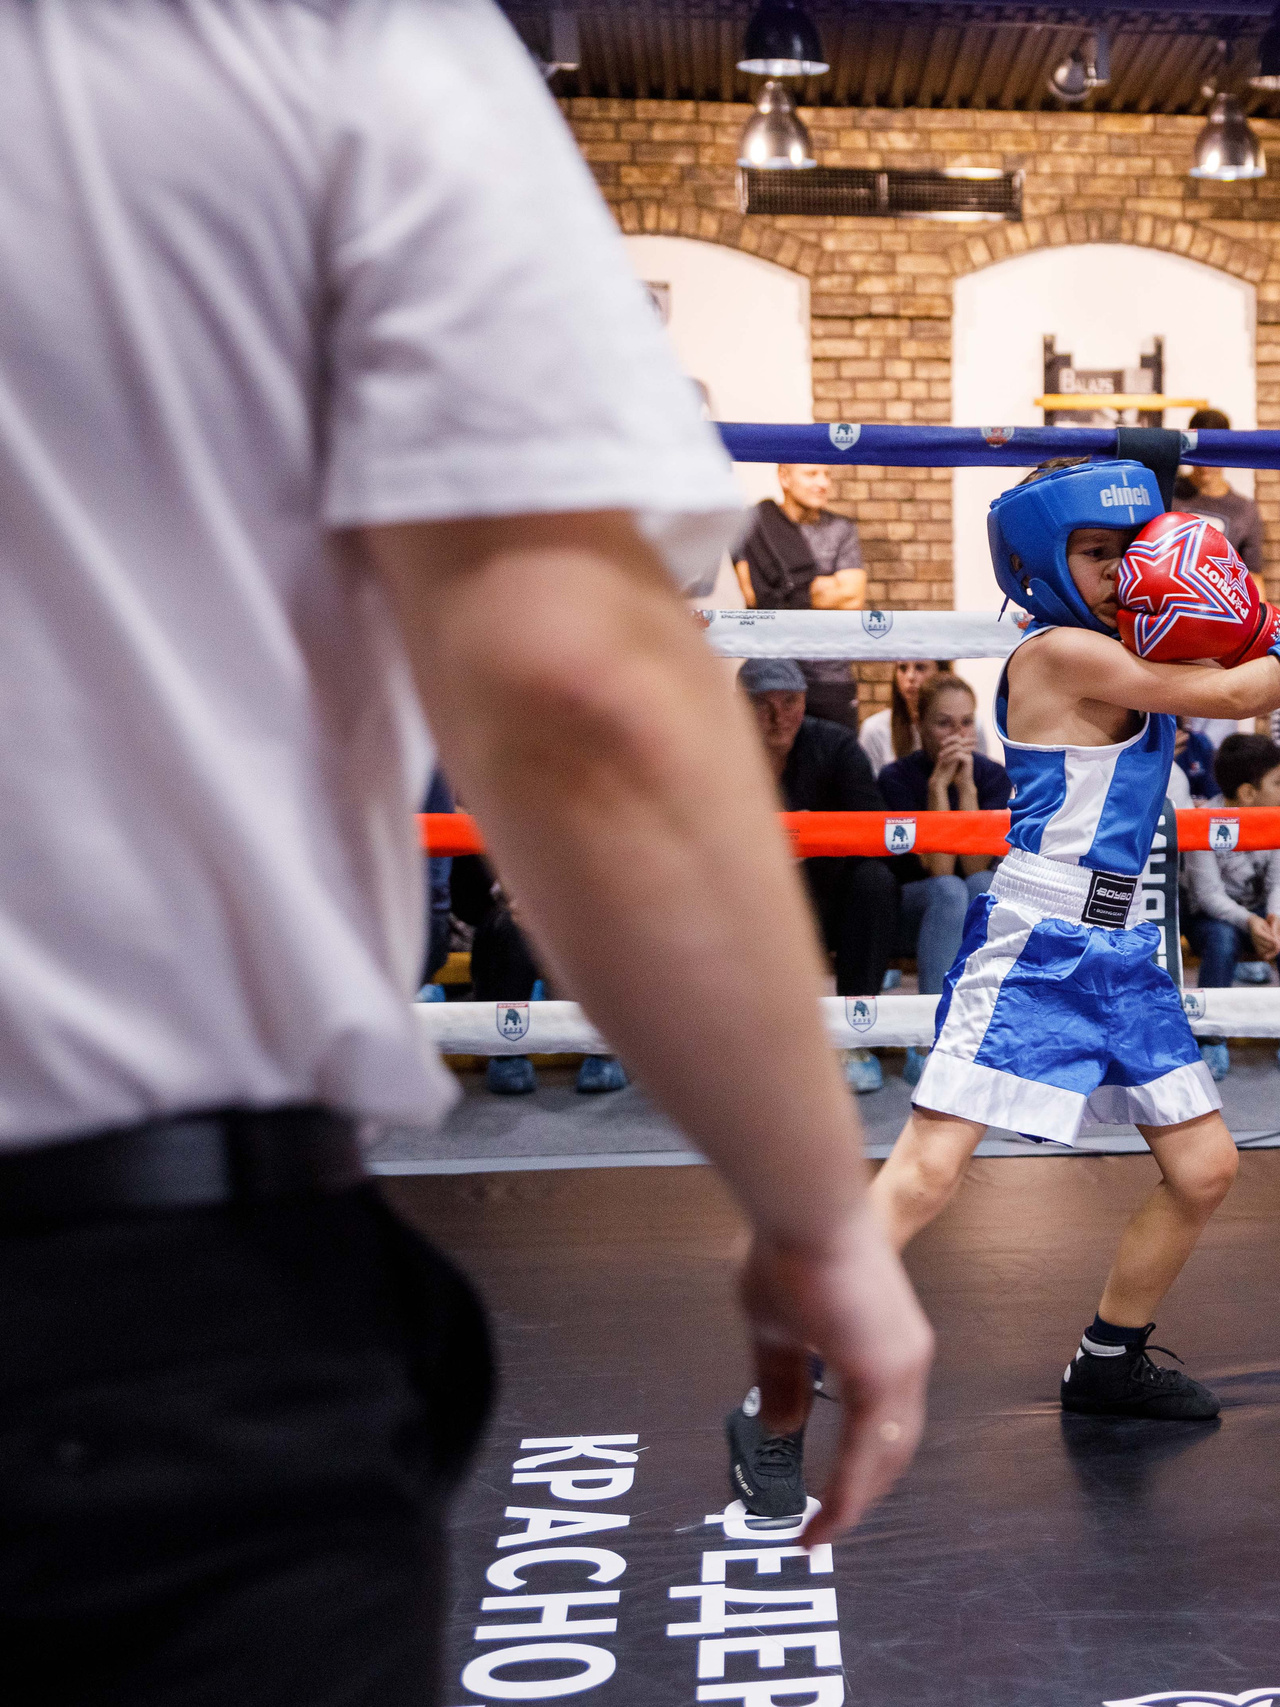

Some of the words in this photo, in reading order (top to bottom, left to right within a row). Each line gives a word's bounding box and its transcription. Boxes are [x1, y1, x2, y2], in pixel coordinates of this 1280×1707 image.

[1100, 483, 1151, 507] clinch
[1096, 887, 1132, 901] BOYBO
[461, 1433, 640, 1707] КРАСНО
